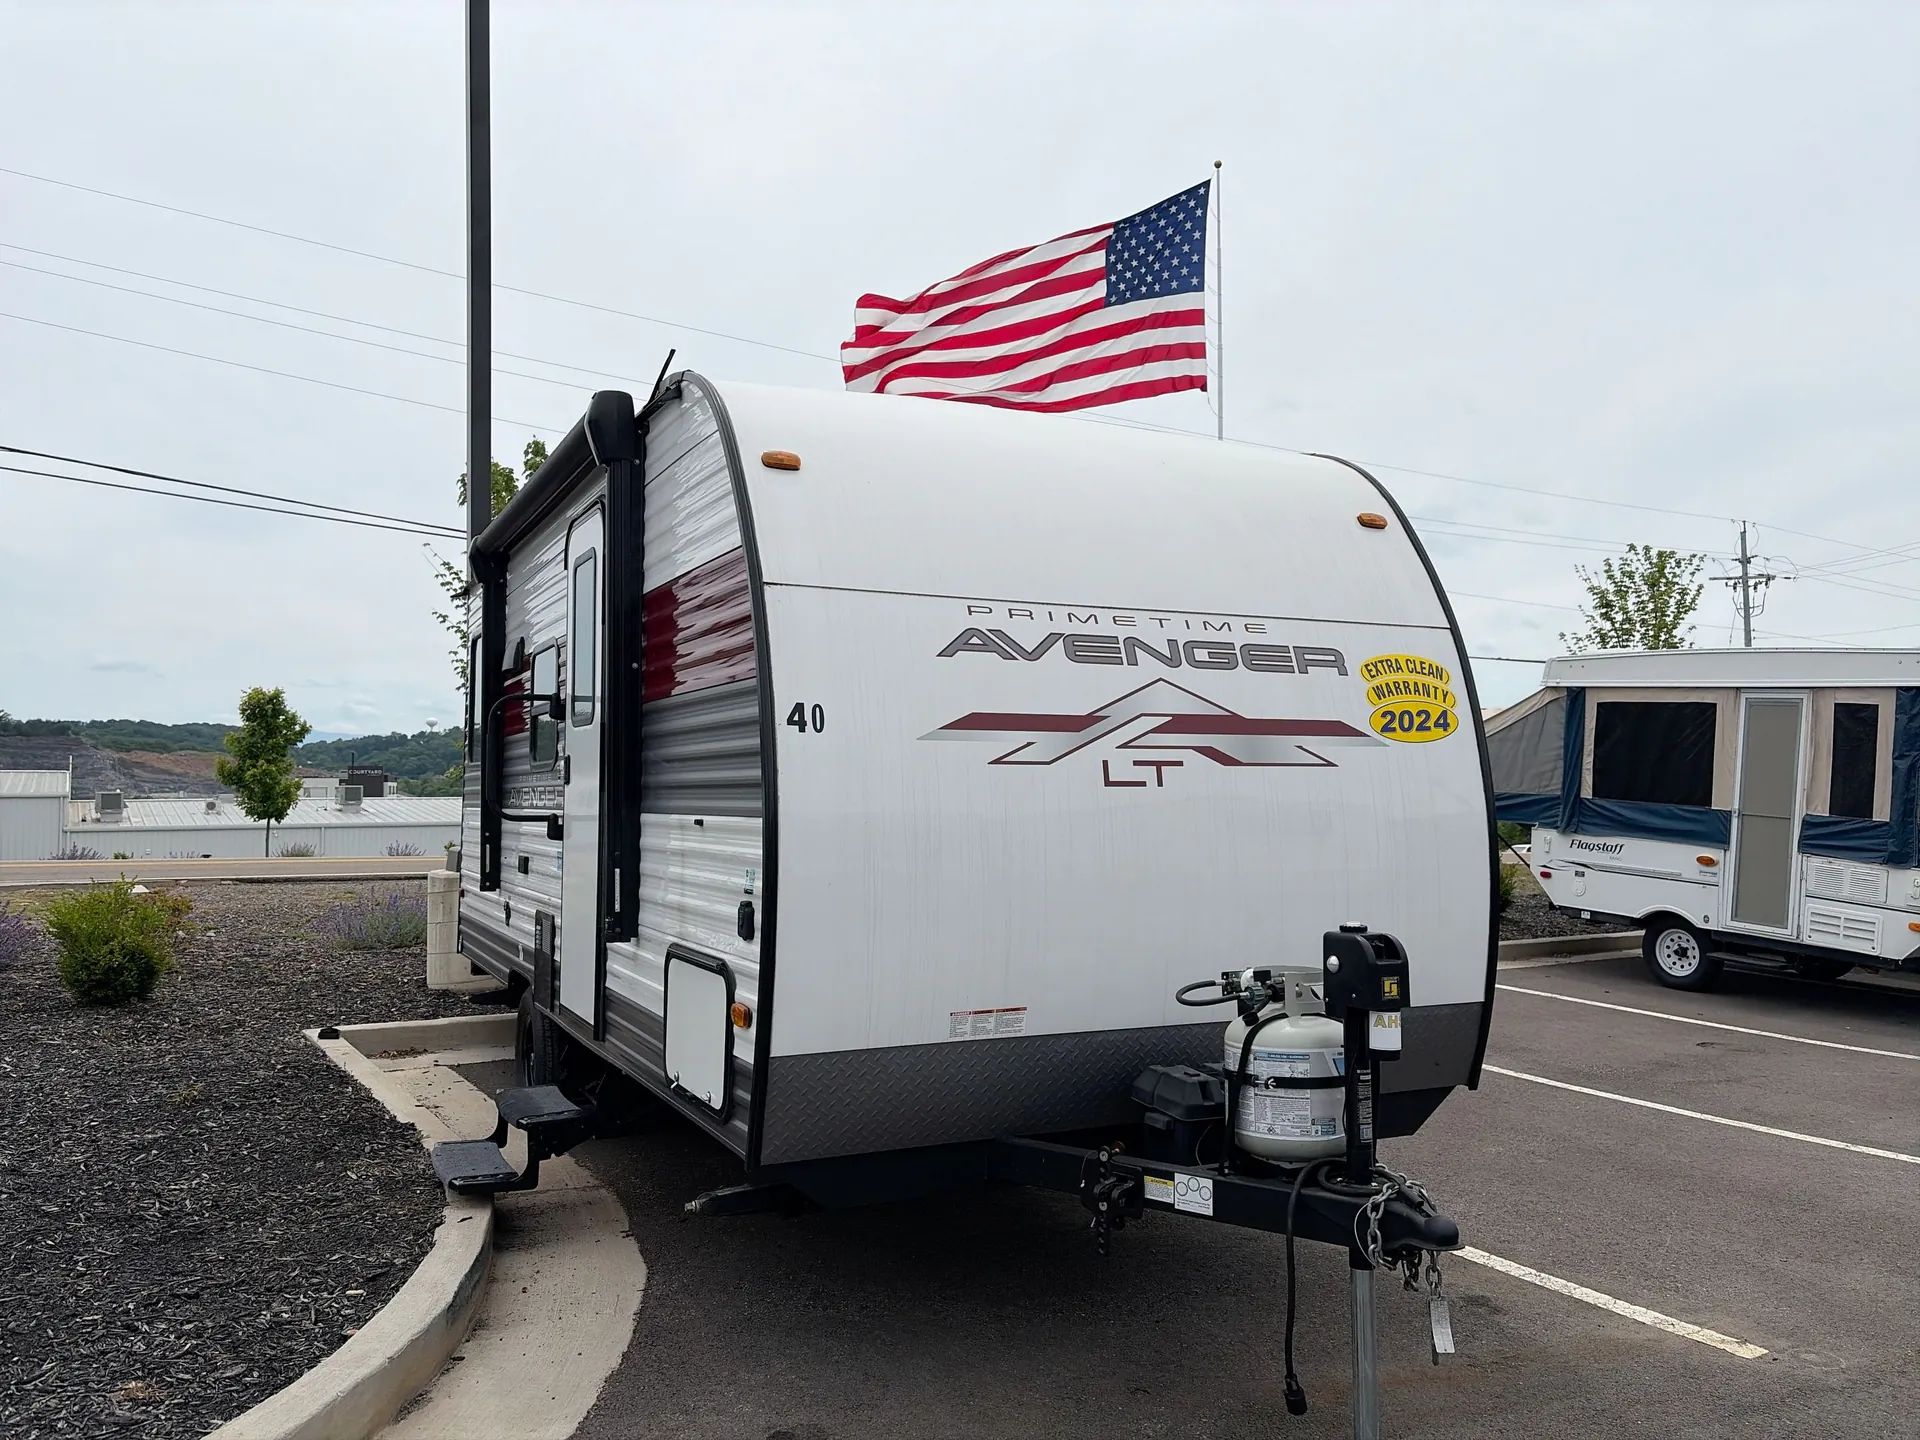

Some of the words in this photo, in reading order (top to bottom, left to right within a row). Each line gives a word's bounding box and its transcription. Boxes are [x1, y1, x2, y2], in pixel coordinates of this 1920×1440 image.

[966, 604, 1268, 635] PRIMETIME
[936, 627, 1349, 677] AVENGER
[1364, 658, 1404, 679] EXTRA
[1405, 658, 1444, 681] CLEAN
[1372, 680, 1449, 703] WARRANTY
[786, 702, 825, 733] 40
[1380, 709, 1450, 733] 2024
[1102, 760, 1184, 787] LT
[1569, 838, 1625, 855] Flagstaff
[1373, 1014, 1401, 1029] AH
